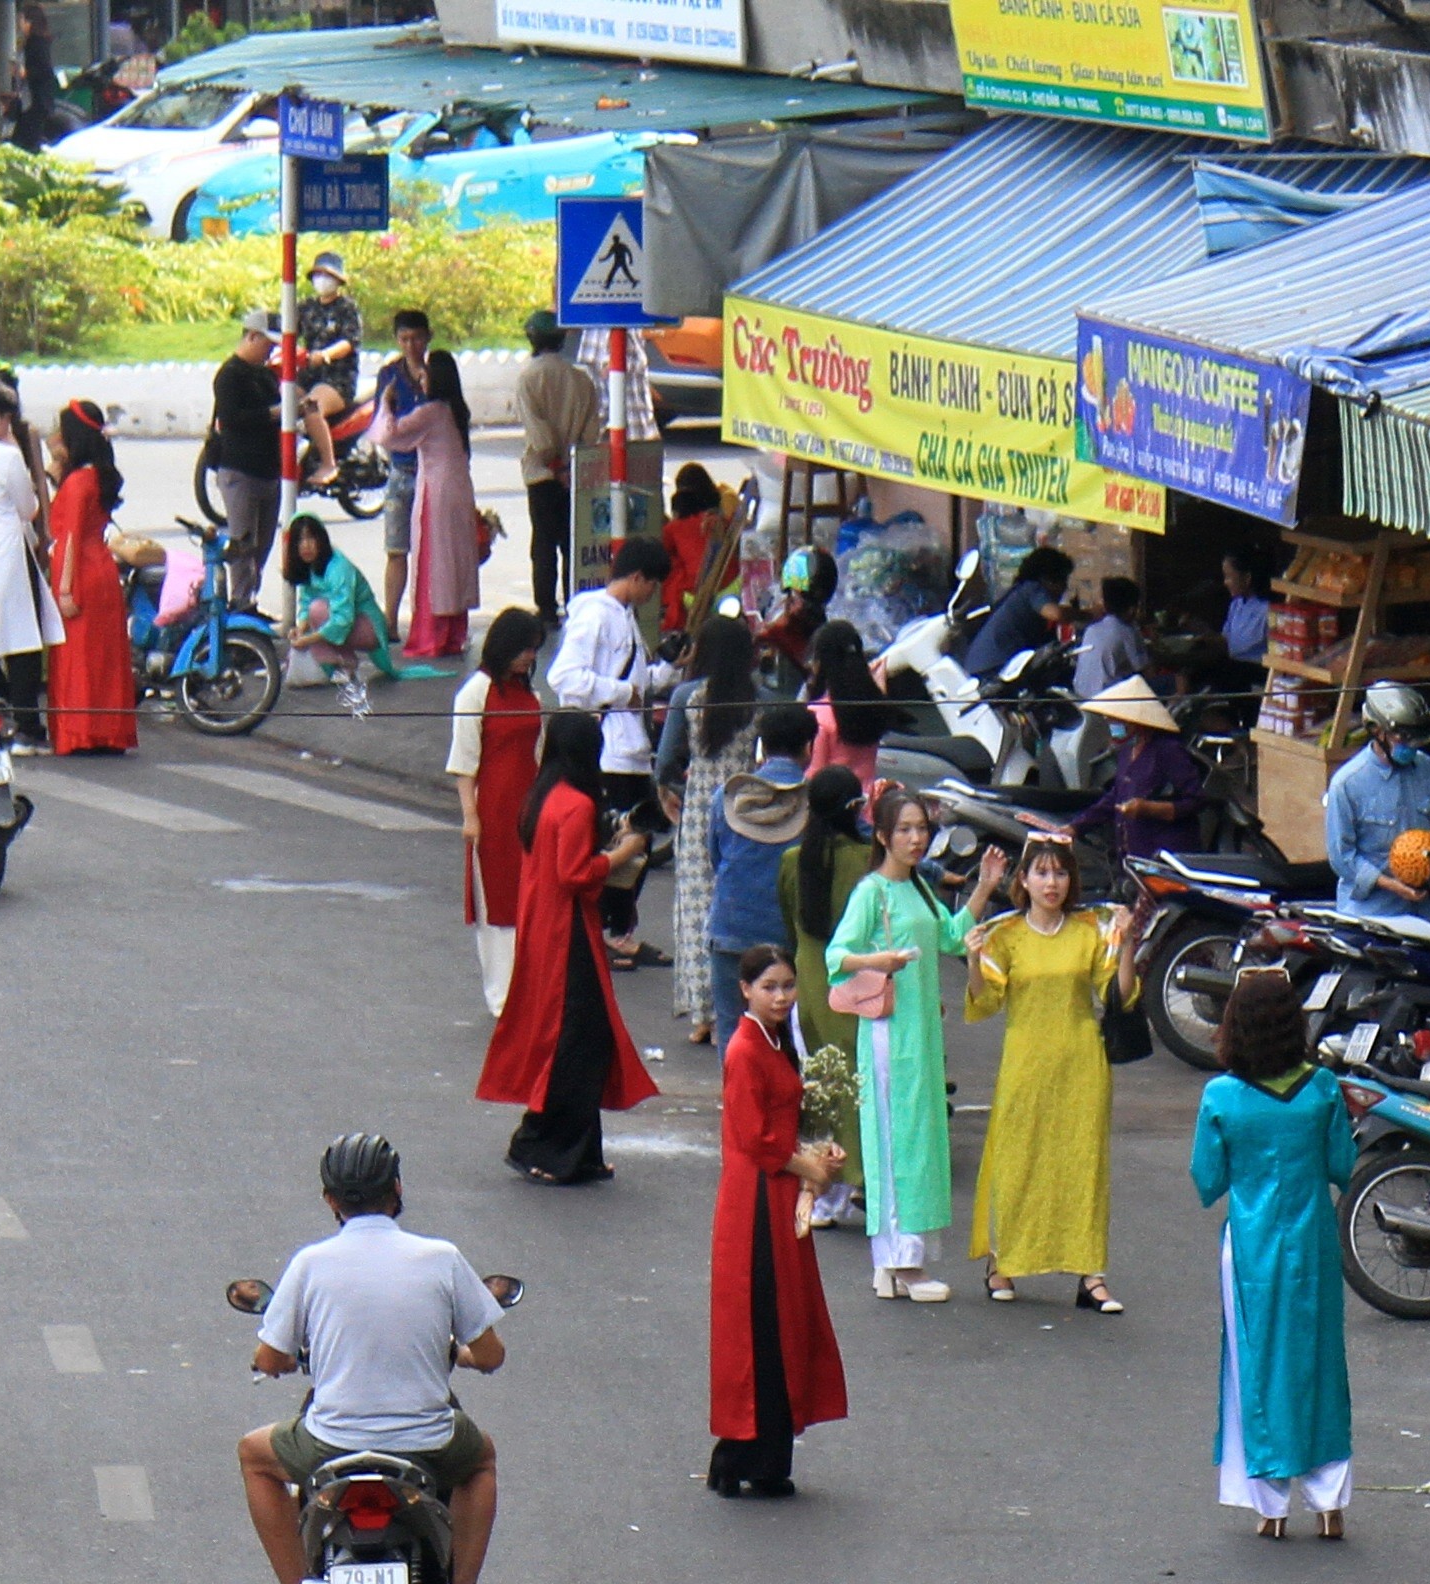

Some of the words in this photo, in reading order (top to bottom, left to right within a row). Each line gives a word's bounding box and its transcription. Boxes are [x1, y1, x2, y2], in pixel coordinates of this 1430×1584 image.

[289, 106, 308, 140] CHỢ
[303, 184, 323, 210] HAI
[326, 177, 341, 210] BÀ
[345, 182, 380, 210] TRƯNG
[890, 343, 932, 402] BÁNH
[937, 359, 981, 413] CANH
[998, 363, 1033, 422] BÚN
[1037, 368, 1057, 427] CÁ
[1128, 340, 1185, 397] MANGO
[1201, 359, 1259, 418] COFFEE
[918, 420, 948, 481] CHẢ
[953, 431, 975, 486] CÁ
[977, 442, 1006, 493] GIA
[1007, 440, 1071, 504] TRUYỀN
